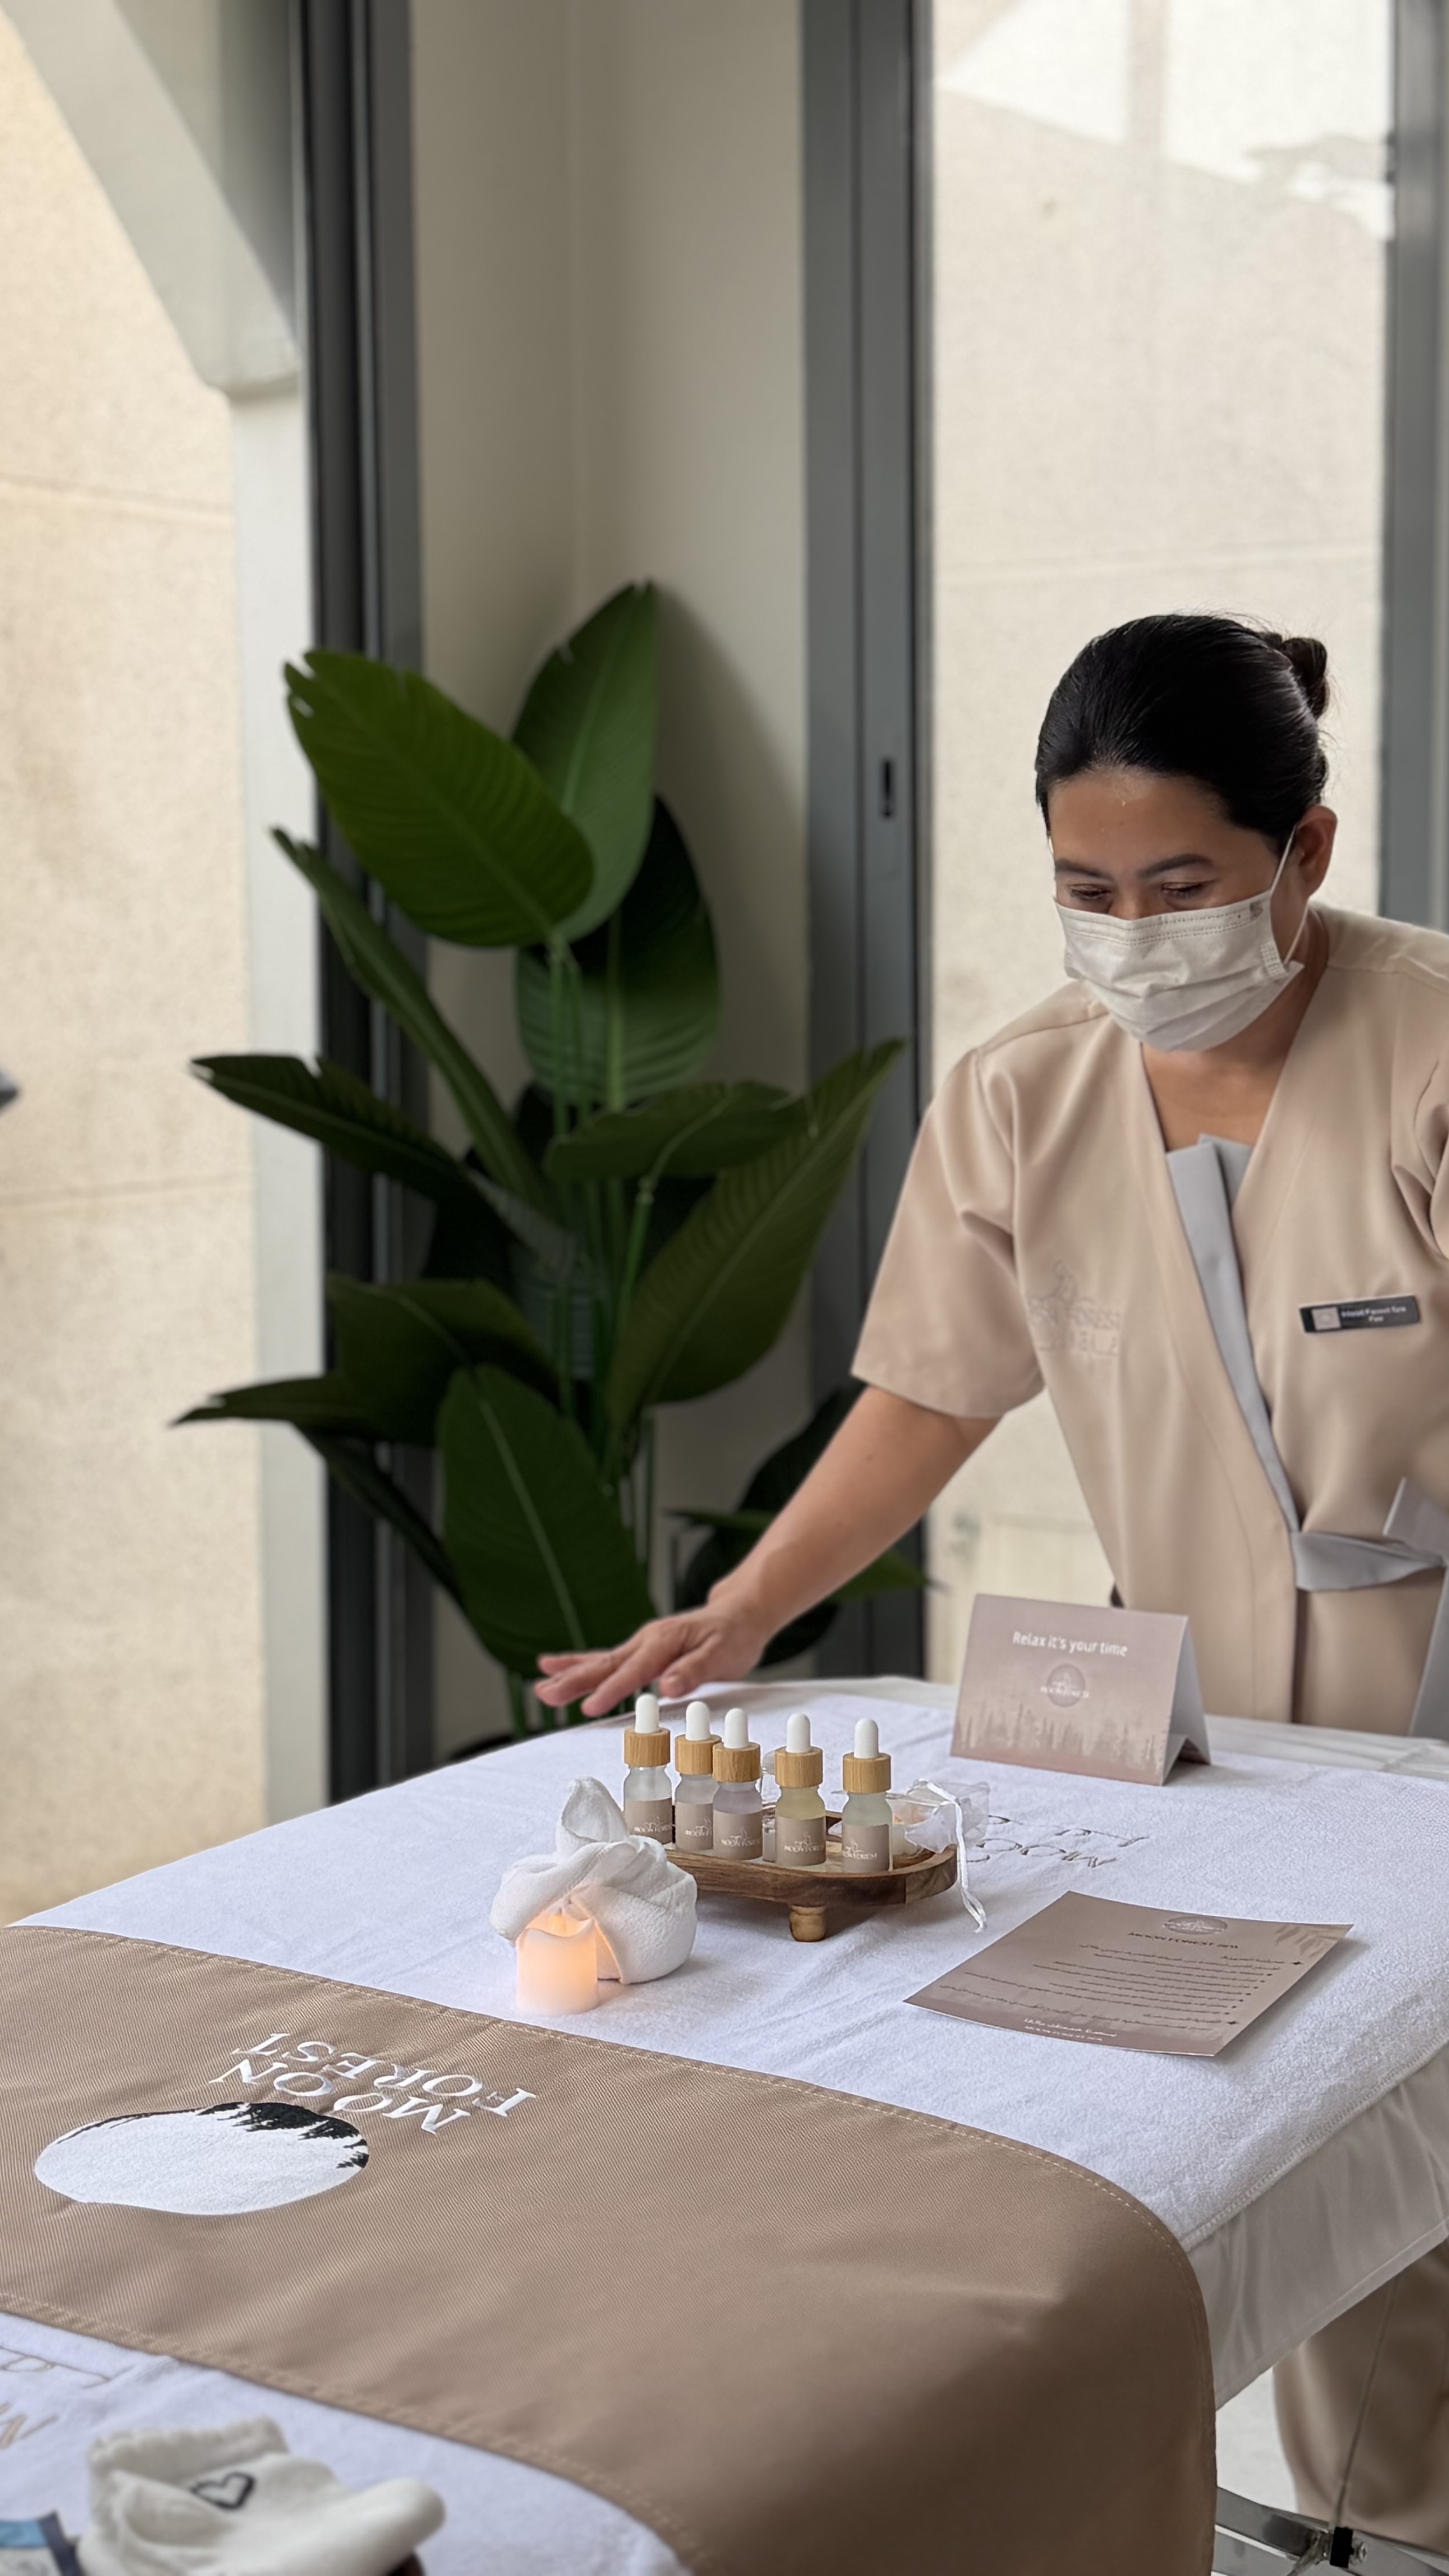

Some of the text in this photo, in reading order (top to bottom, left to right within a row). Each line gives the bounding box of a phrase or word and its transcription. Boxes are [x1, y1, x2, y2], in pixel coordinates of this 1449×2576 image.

[1012, 1631, 1128, 1657] Relax it's your time
[208, 2058, 471, 2135] MOON
[230, 2032, 536, 2117] FOREST
